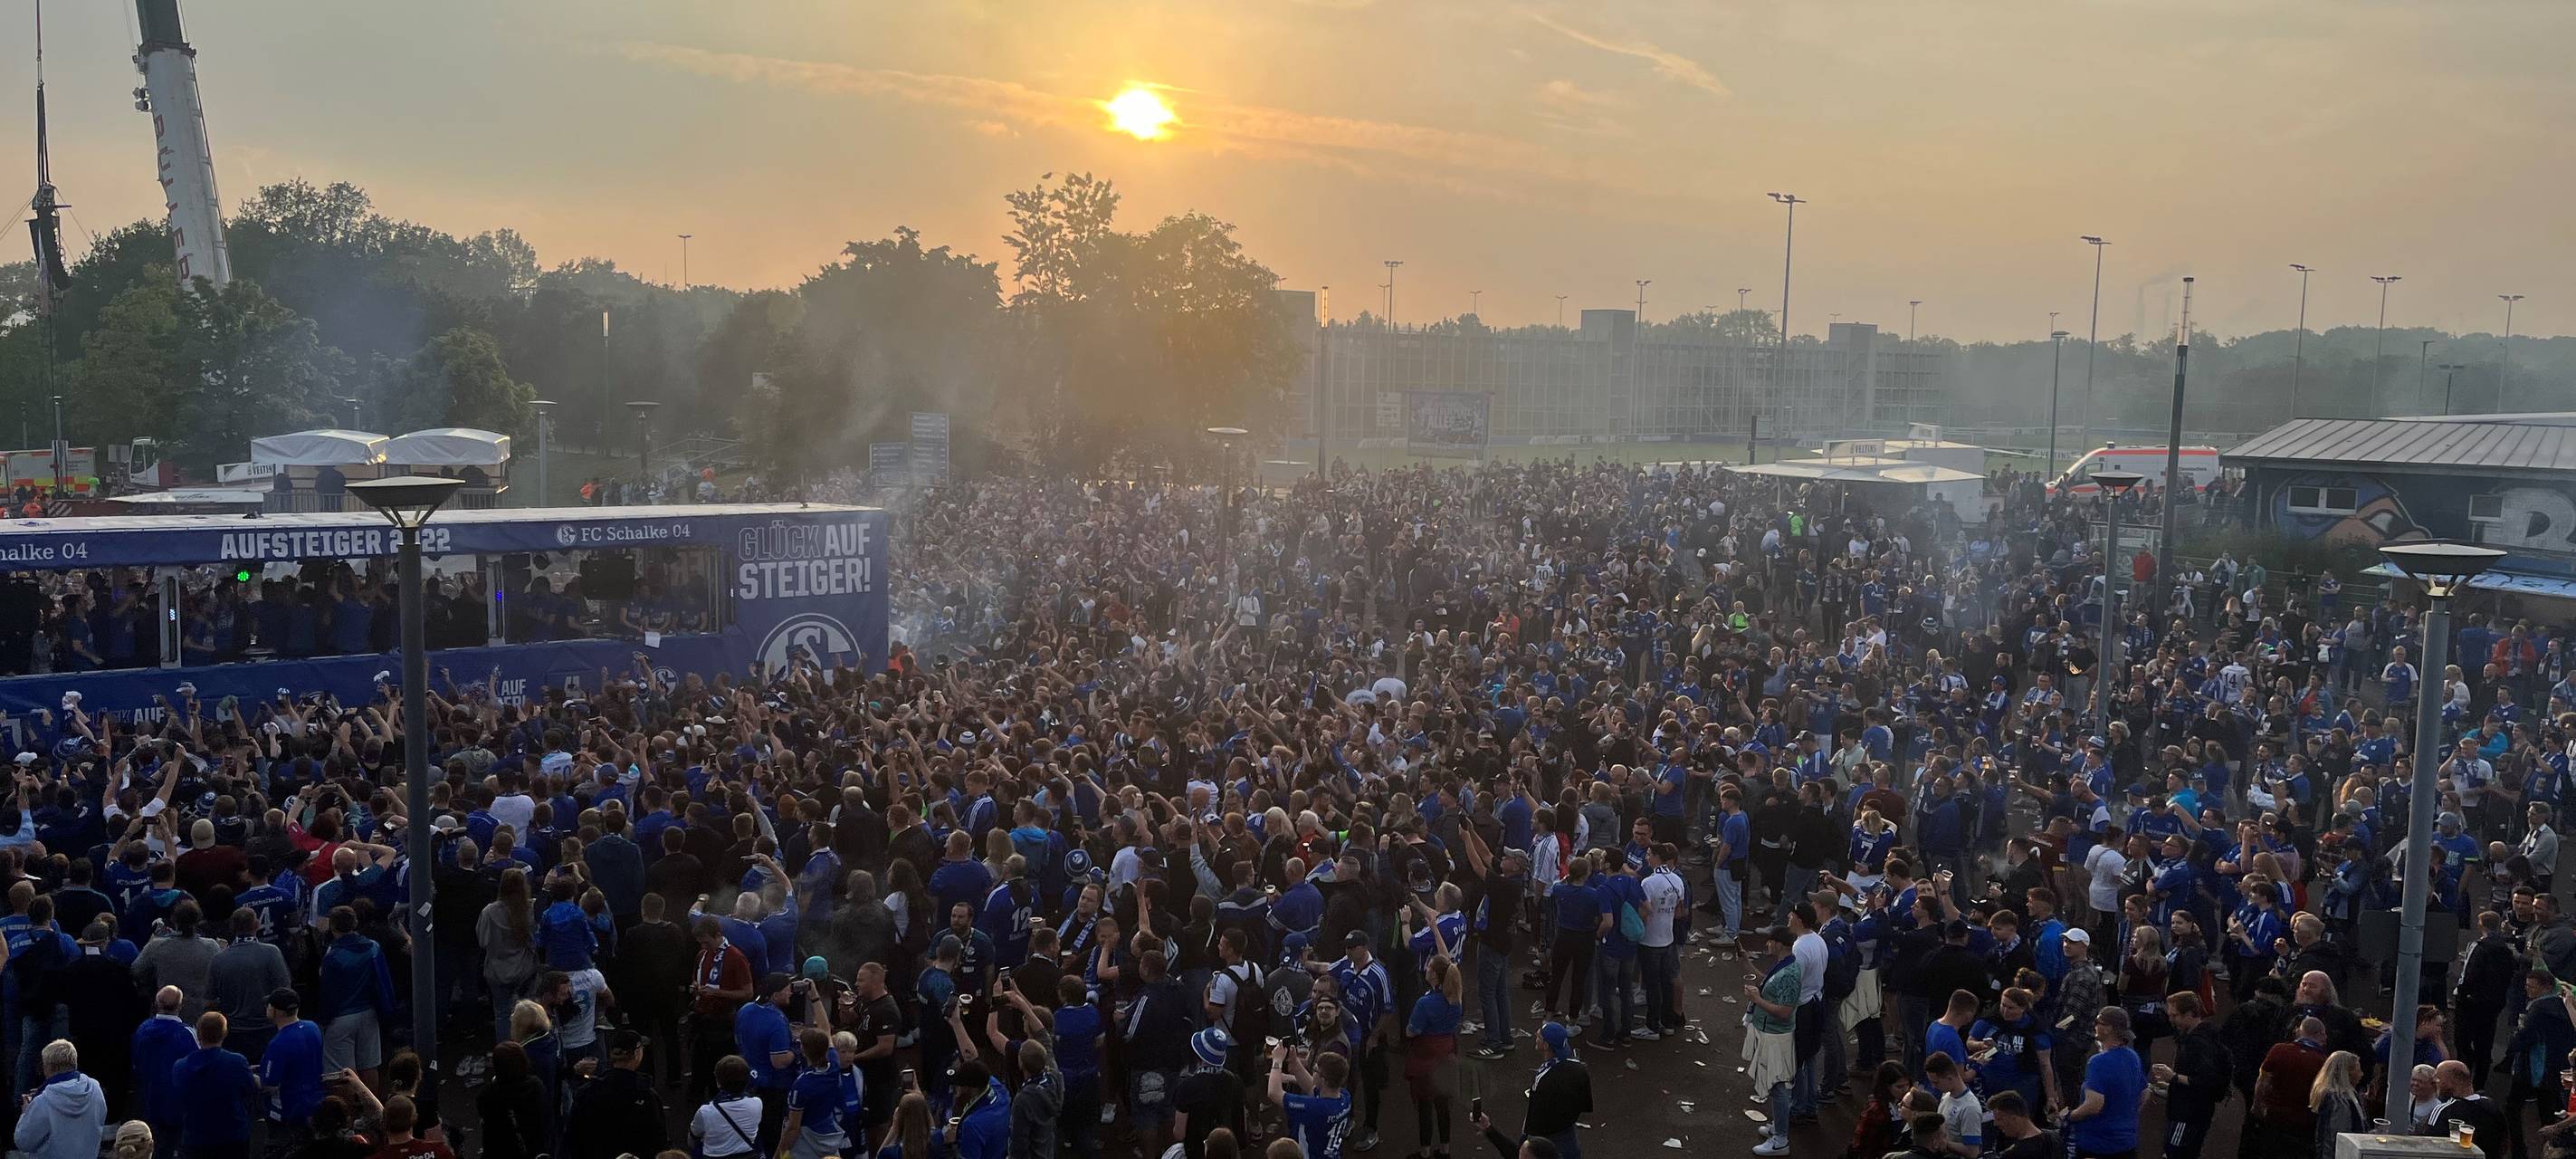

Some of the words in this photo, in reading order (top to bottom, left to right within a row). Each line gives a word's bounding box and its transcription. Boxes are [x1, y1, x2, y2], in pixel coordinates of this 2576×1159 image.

[581, 527, 603, 541] FC
[607, 525, 669, 541] Schalke
[673, 523, 691, 538] 04
[738, 520, 819, 561] GLÜCK
[824, 523, 871, 558] AUF
[62, 542, 89, 560] 04
[221, 530, 381, 560] AUFSTEIGER
[389, 528, 451, 556] 222
[739, 558, 872, 600] STEIGER!
[501, 679, 527, 696] AUF
[2224, 673, 2237, 689] 14
[134, 706, 165, 726] AUF
[1861, 841, 1874, 863] 7
[259, 906, 275, 935] 4
[1011, 905, 1032, 933] 12
